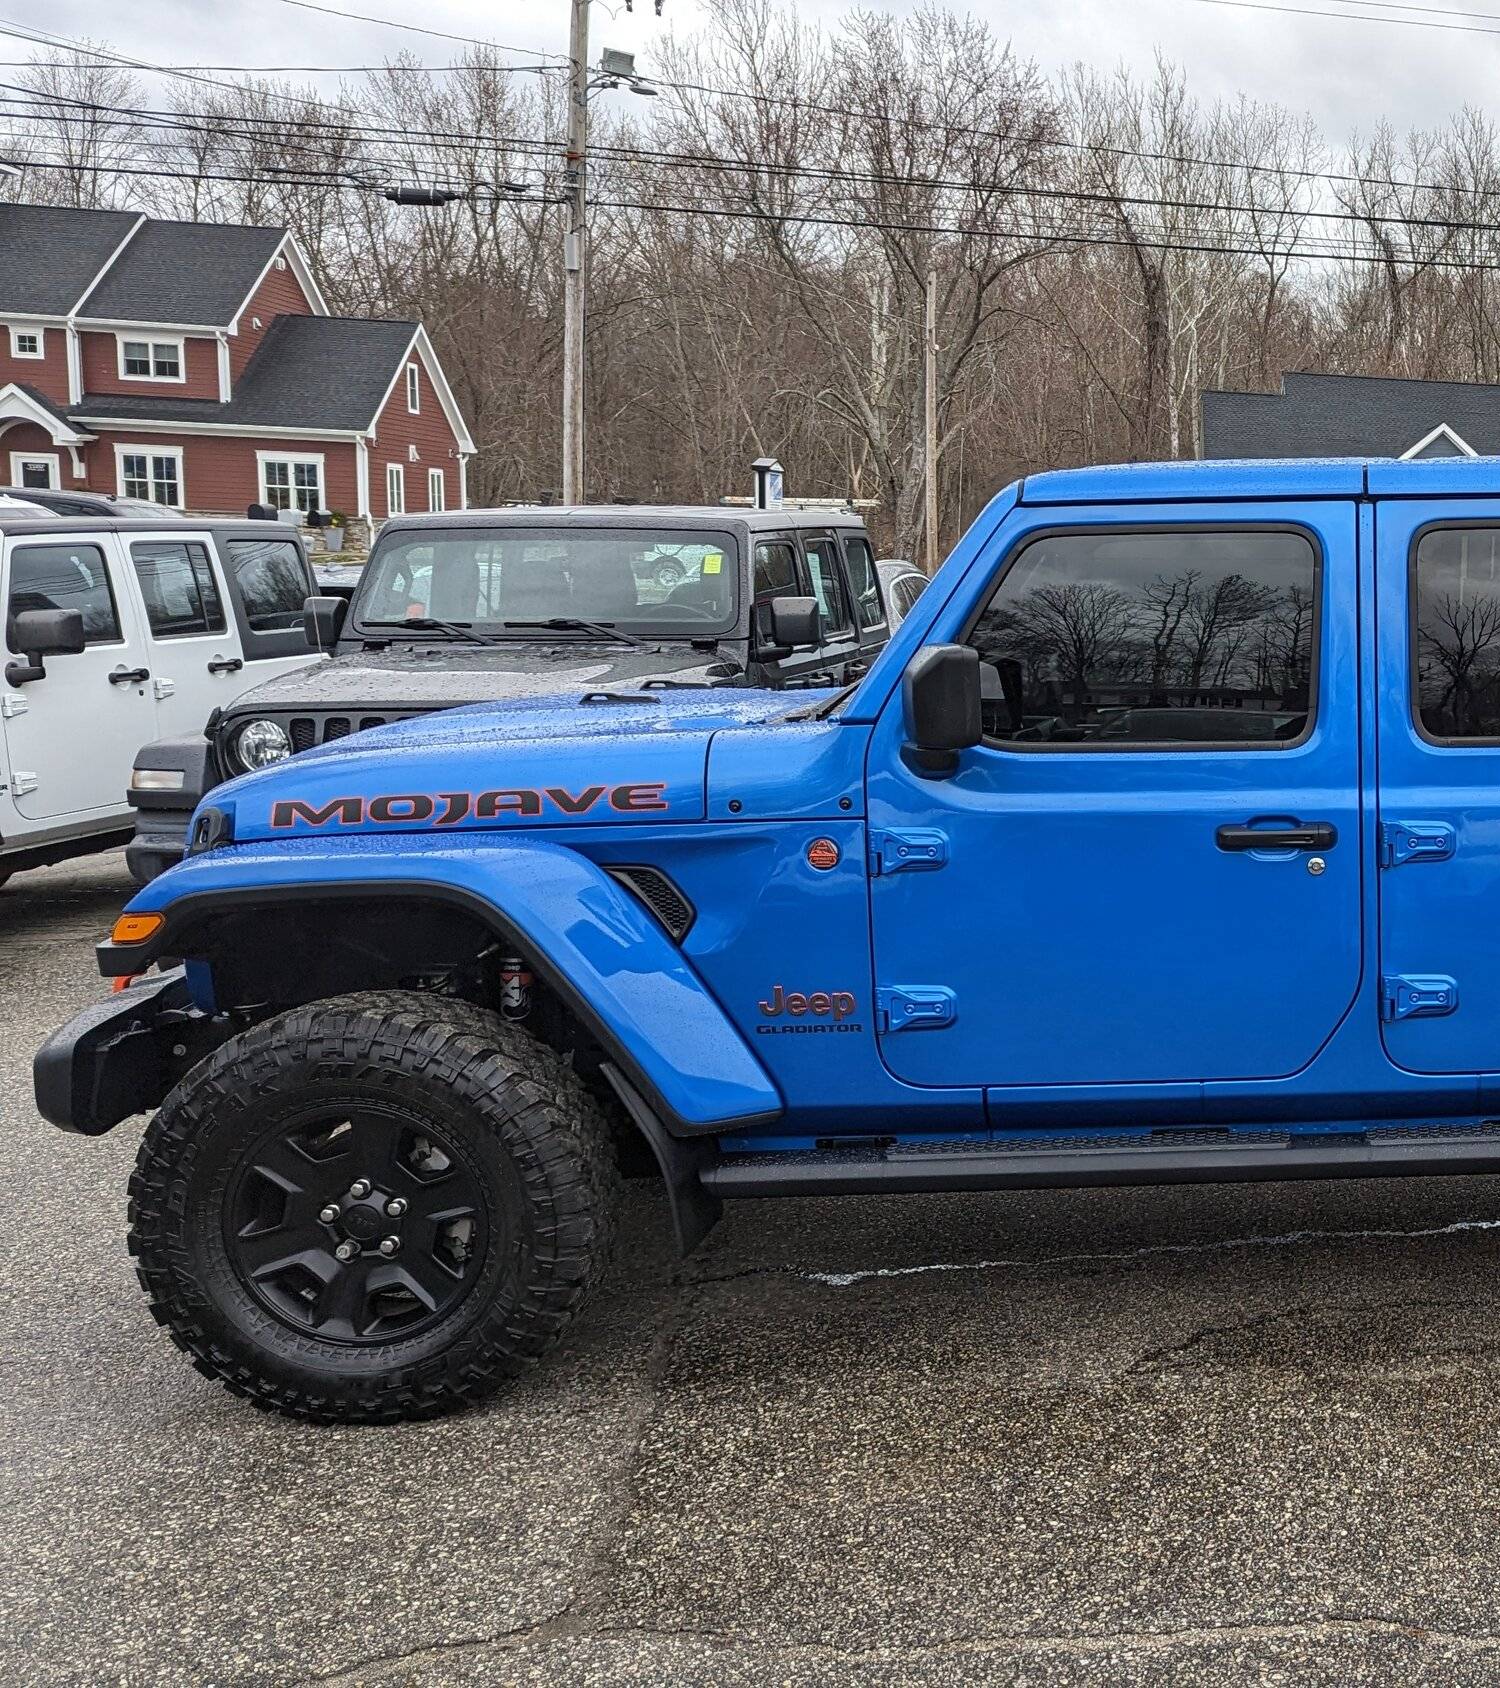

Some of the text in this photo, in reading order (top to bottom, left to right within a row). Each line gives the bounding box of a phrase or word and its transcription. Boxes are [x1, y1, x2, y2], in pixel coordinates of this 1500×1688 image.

[271, 783, 668, 828] MOJAVE
[759, 985, 855, 1021] Jeep
[756, 1024, 863, 1035] GLADIATOR
